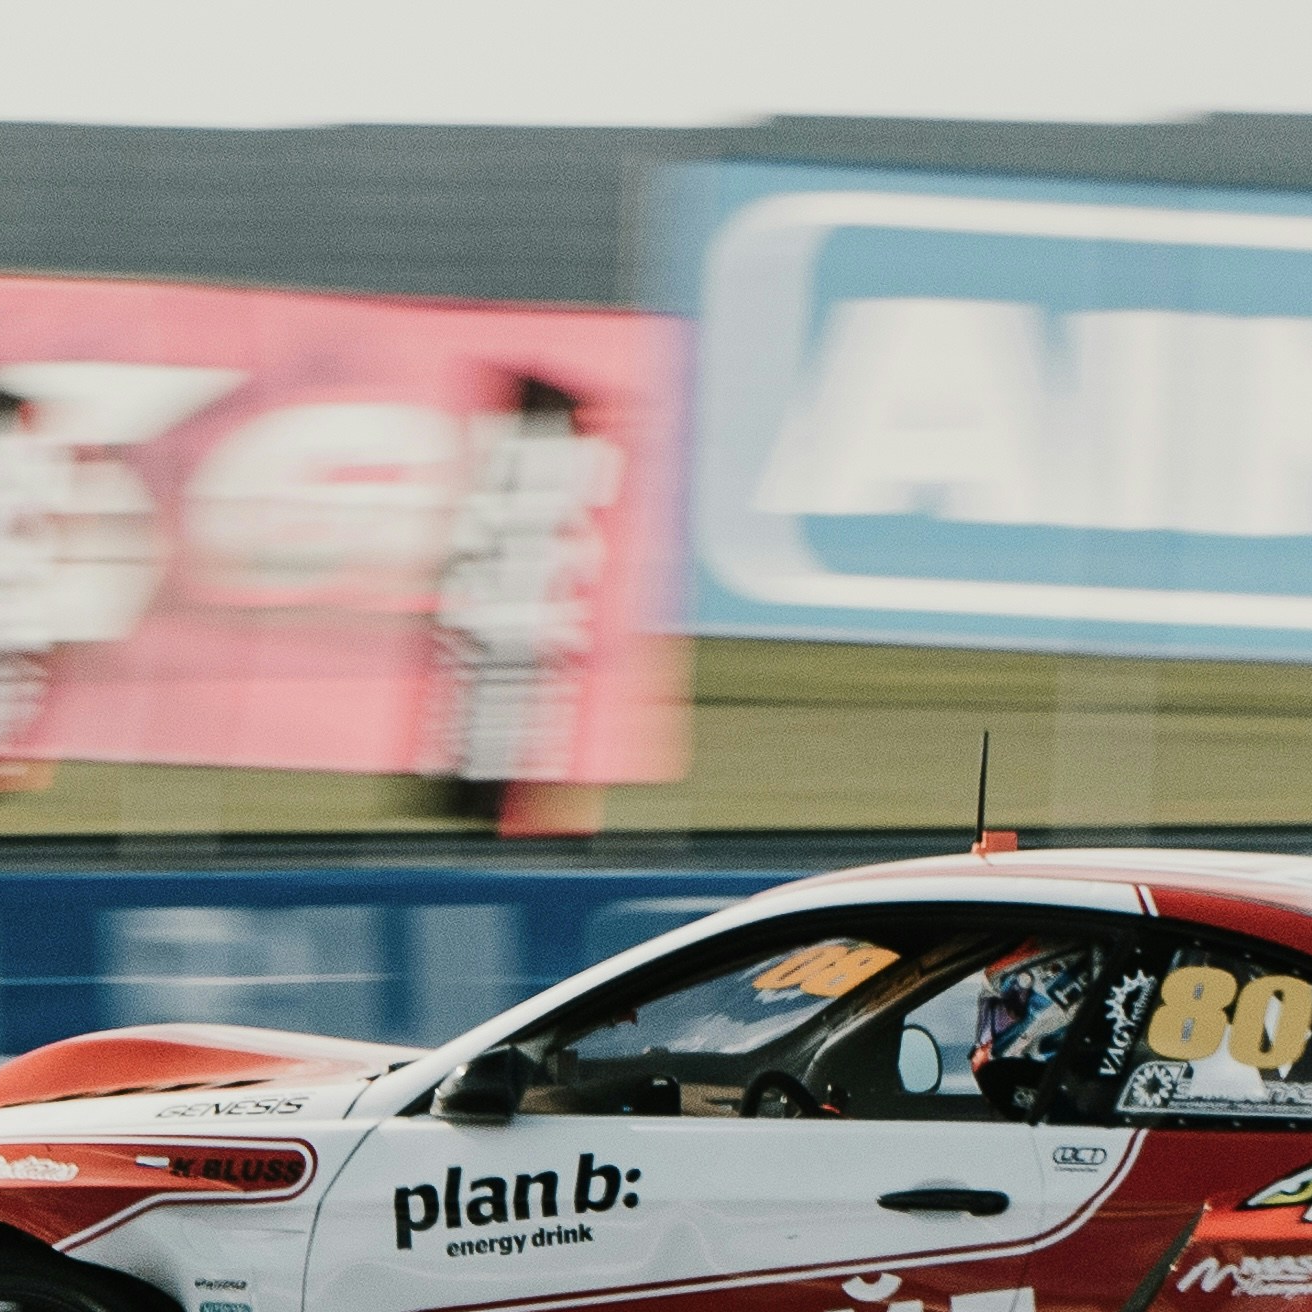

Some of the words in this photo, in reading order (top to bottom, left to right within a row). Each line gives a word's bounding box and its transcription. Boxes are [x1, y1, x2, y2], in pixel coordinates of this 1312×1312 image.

[155, 1096, 309, 1118] GENESIS
[394, 1165, 559, 1250] plan
[446, 1233, 527, 1257] energy
[531, 1223, 594, 1248] drink
